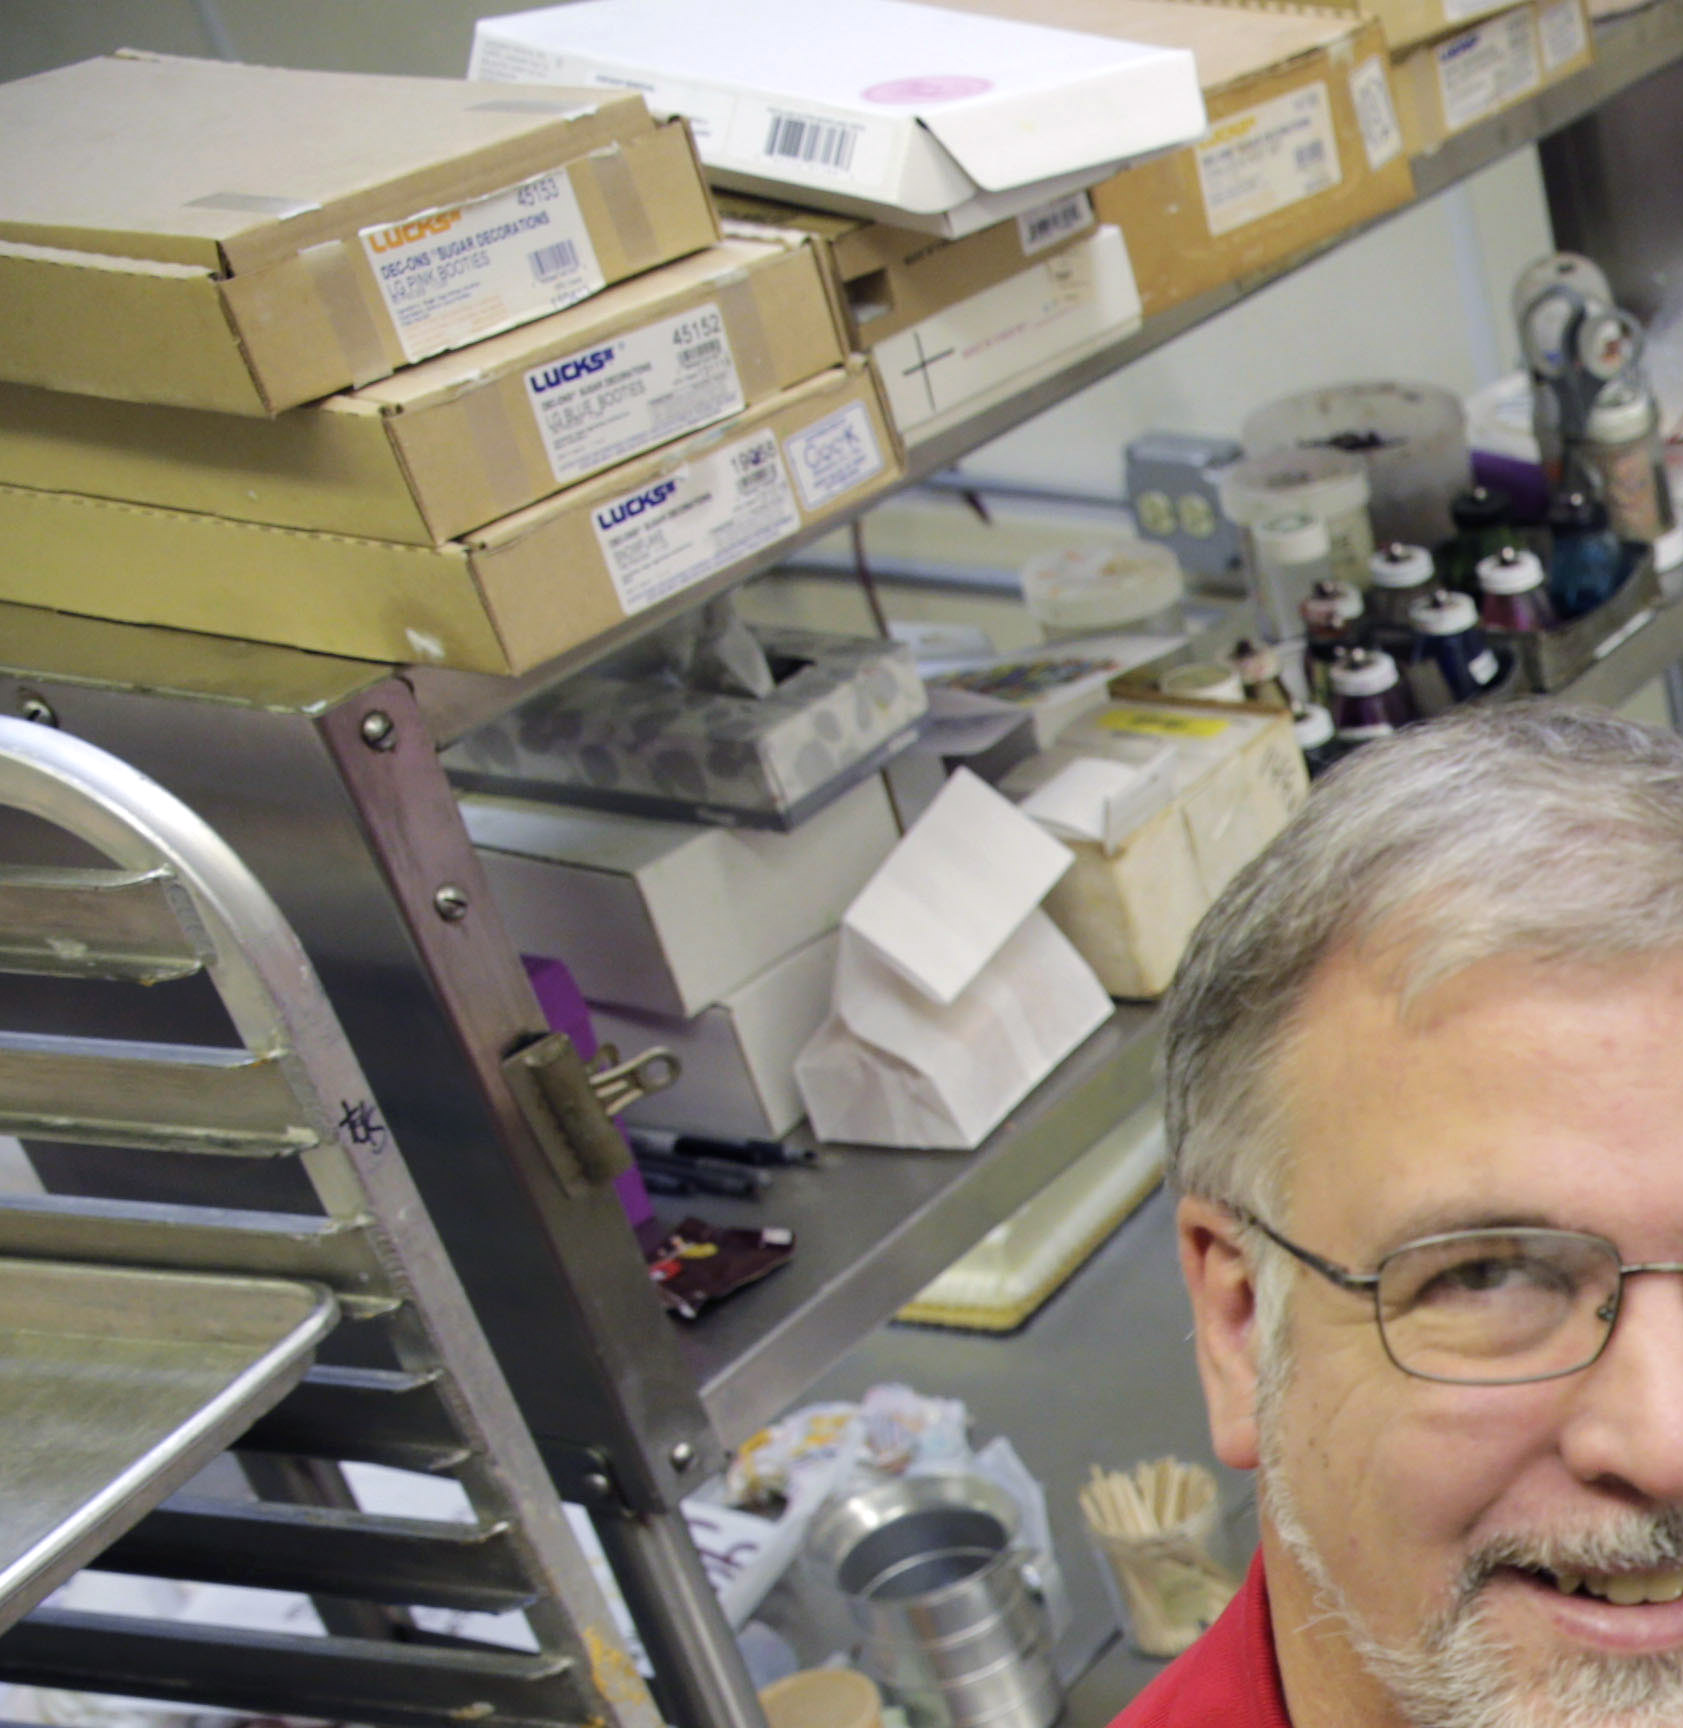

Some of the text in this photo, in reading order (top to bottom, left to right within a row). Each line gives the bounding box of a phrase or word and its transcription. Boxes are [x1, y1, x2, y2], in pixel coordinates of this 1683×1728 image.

[369, 210, 461, 253] LUCKS
[475, 210, 551, 248] DECORATIONS
[438, 250, 491, 282] BOOTIES
[673, 314, 722, 346] 45152
[530, 347, 615, 393] LUCKS
[598, 480, 676, 530] LUCKS
